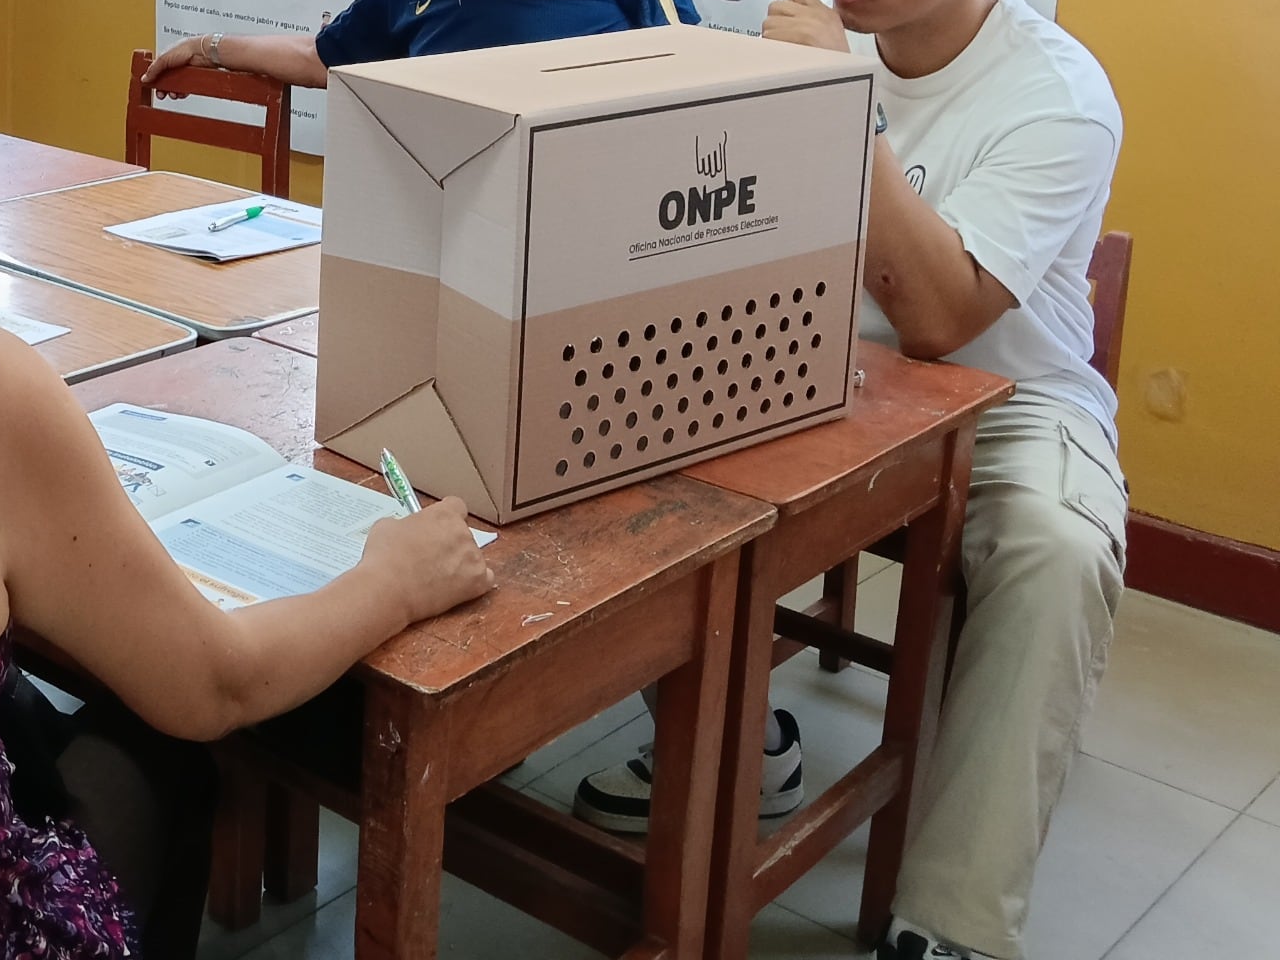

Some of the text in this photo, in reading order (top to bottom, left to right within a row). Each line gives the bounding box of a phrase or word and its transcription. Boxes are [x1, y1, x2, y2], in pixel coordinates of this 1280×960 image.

[234, 13, 256, 22] mucho
[256, 15, 274, 26] jabón
[280, 21, 295, 30] agua
[658, 175, 757, 230] ONPE
[629, 215, 779, 254] Oficina Nacional de Procesos Electorales
